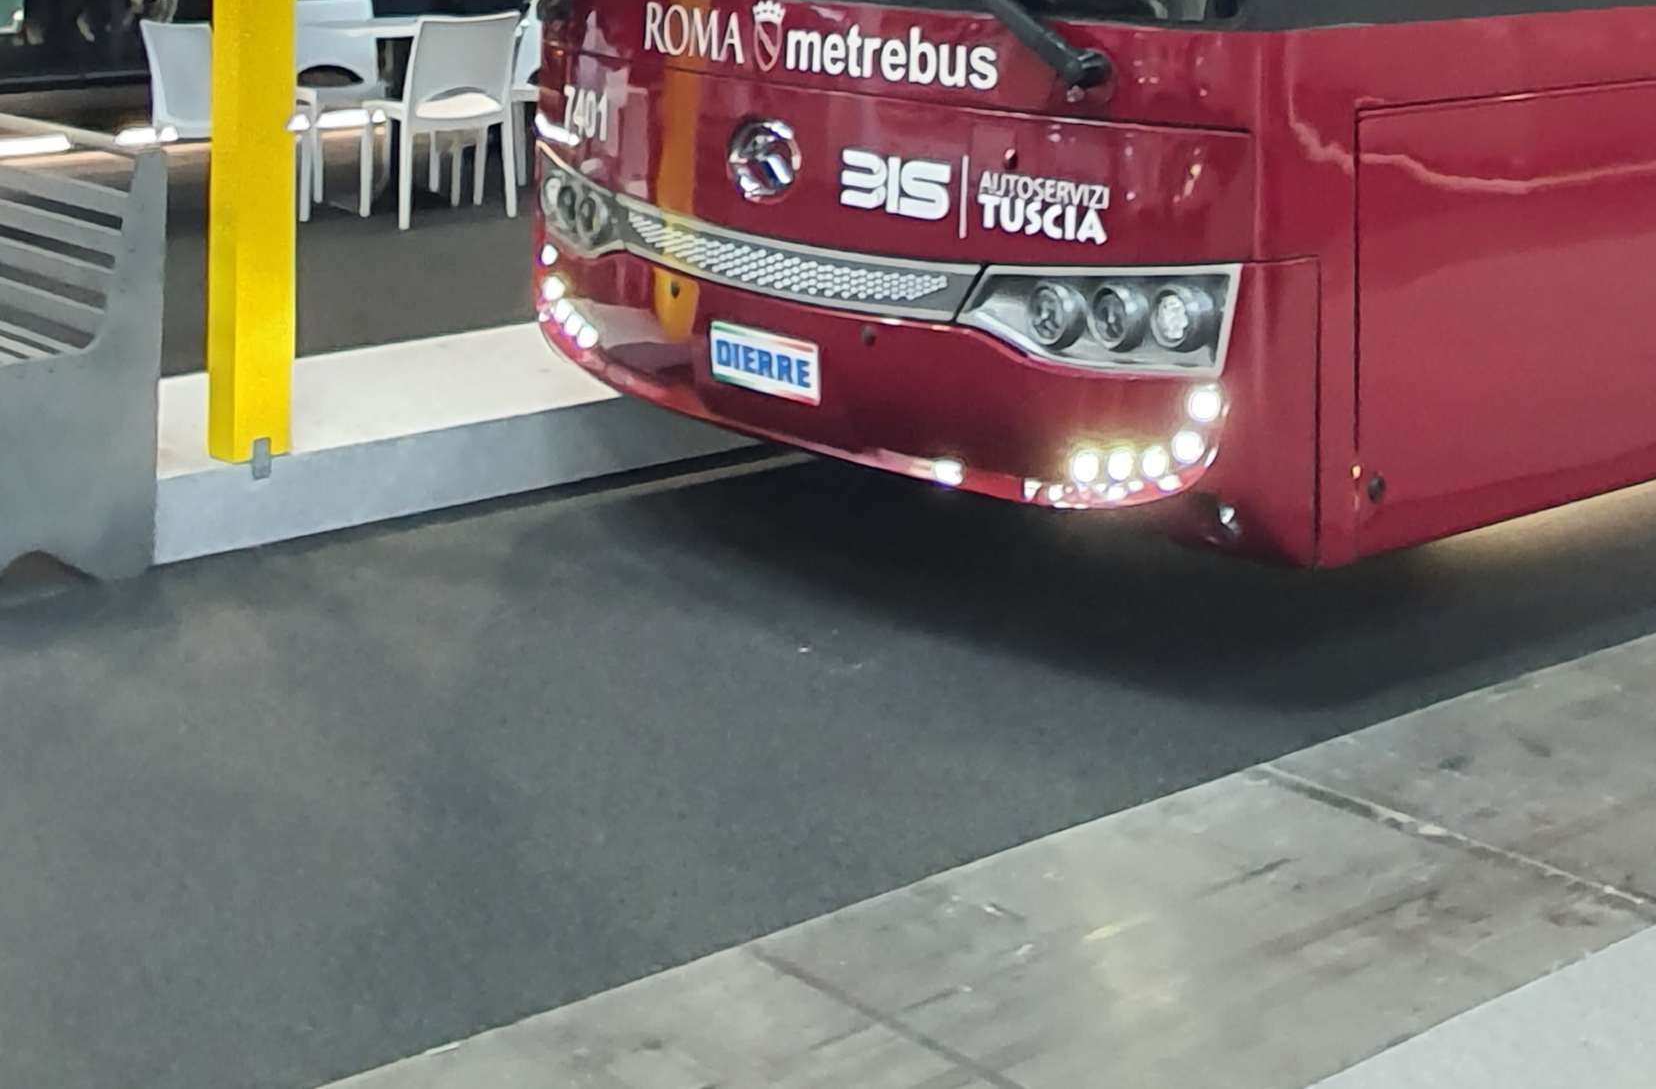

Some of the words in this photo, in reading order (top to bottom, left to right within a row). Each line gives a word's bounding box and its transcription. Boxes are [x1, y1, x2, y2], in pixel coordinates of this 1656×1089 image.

[644, 2, 744, 65] ROMA
[786, 25, 999, 89] metrebus
[977, 170, 1110, 209] AUTOSERVIZI
[977, 194, 1108, 245] TUSCIA
[716, 339, 811, 388] DIERRE
